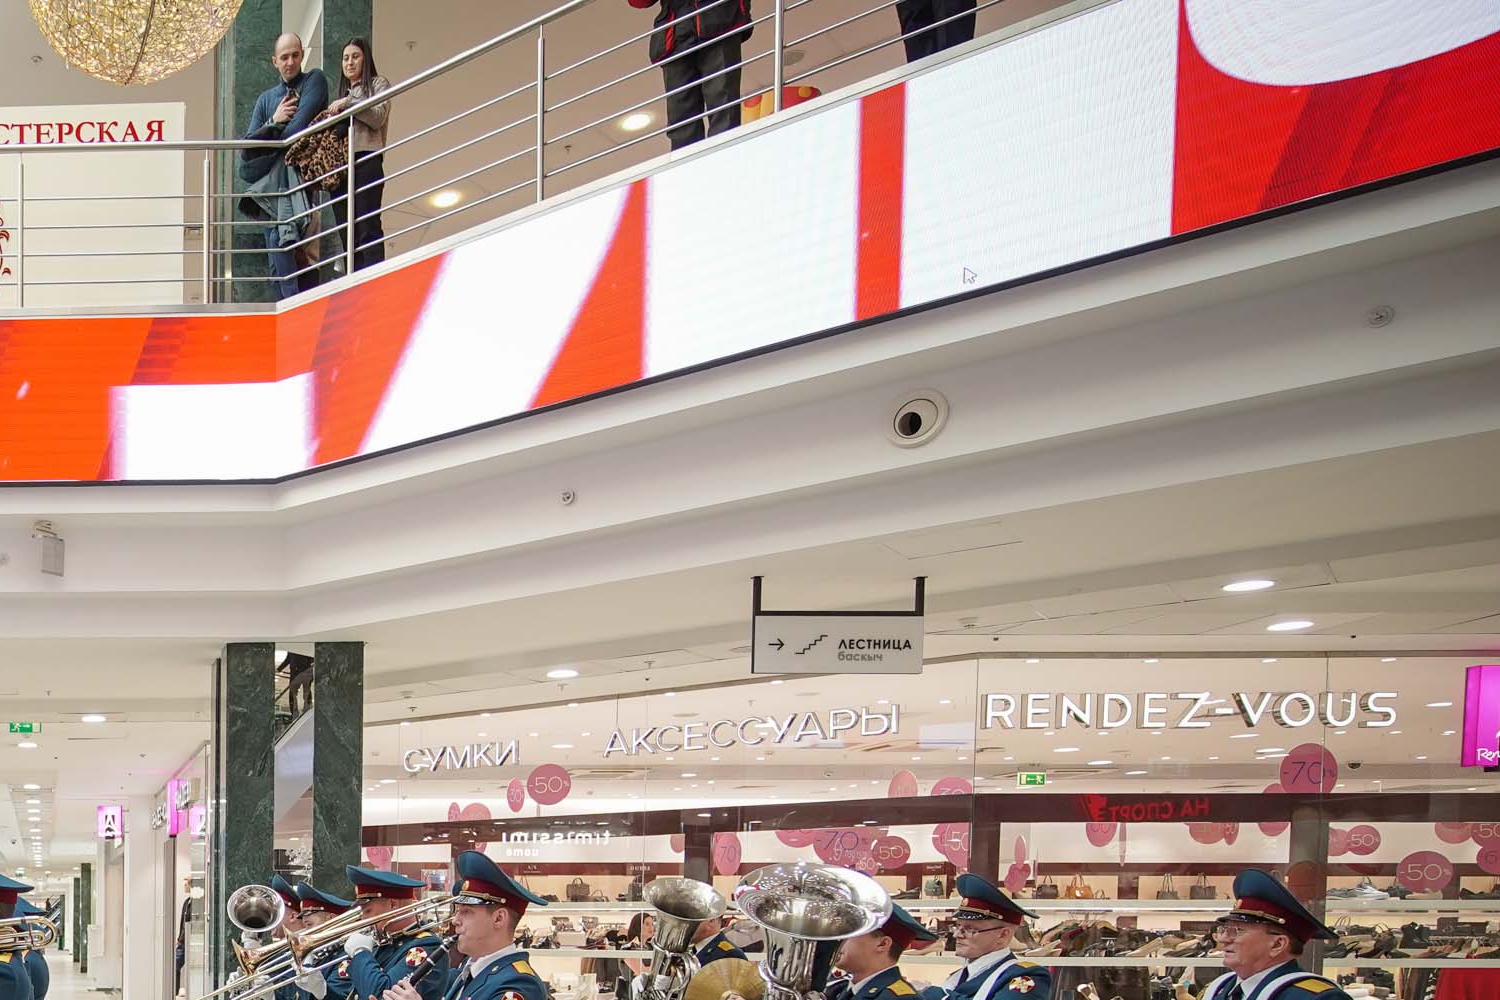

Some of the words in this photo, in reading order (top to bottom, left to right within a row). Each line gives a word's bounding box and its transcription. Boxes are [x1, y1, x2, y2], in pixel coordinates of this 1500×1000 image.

[837, 650, 883, 662] баскыч
[838, 639, 912, 653] ЛЕСТНИЦА
[982, 692, 1399, 728] RENDEZ-VOUS
[603, 704, 900, 758] АКСЕССУАРЫ
[403, 740, 520, 773] СУМКИ
